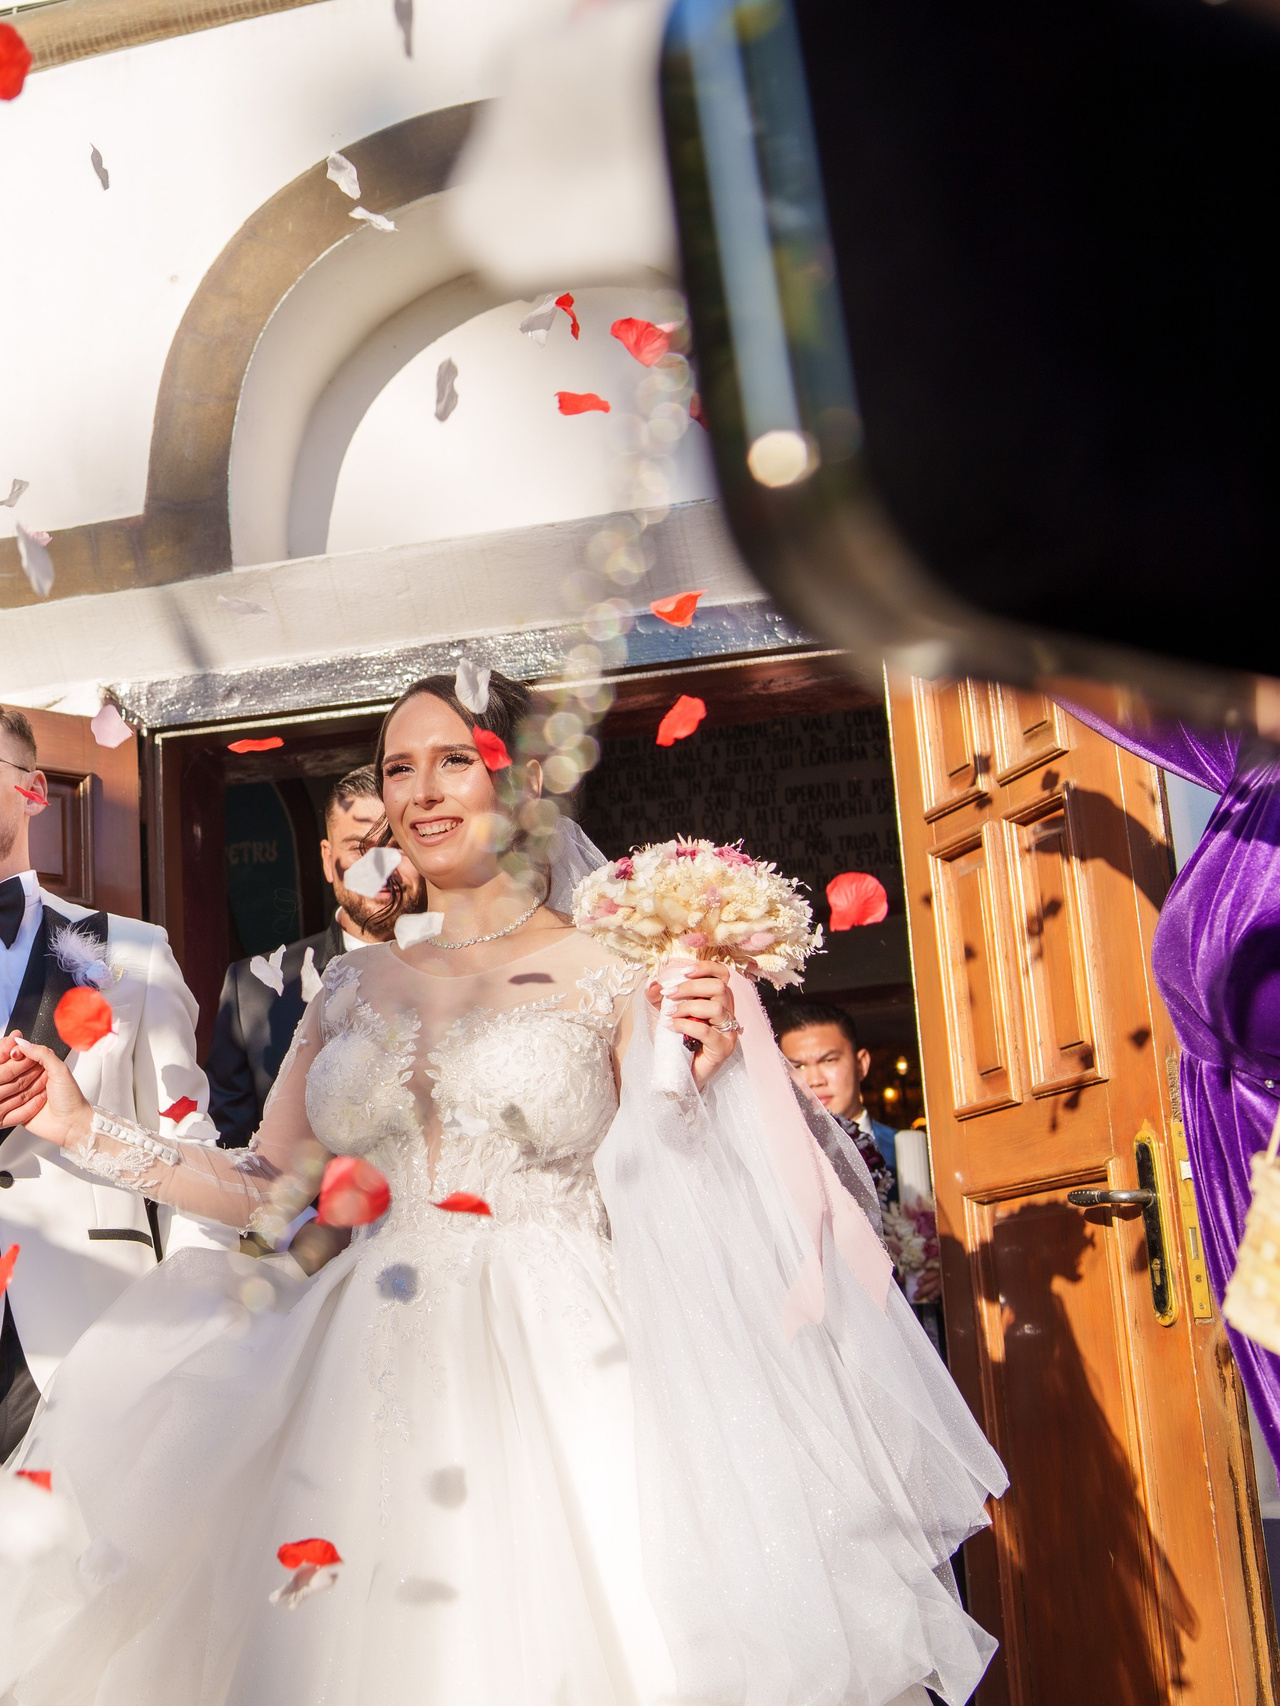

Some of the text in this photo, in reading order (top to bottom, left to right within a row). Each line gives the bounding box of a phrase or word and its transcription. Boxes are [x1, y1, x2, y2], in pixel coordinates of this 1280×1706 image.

[800, 712, 833, 732] VALE
[701, 761, 716, 777] CU
[771, 751, 793, 771] LUI
[658, 798, 692, 818] 2007
[704, 793, 732, 813] SAU
[848, 779, 864, 799] DE
[755, 805, 787, 826] ALTE
